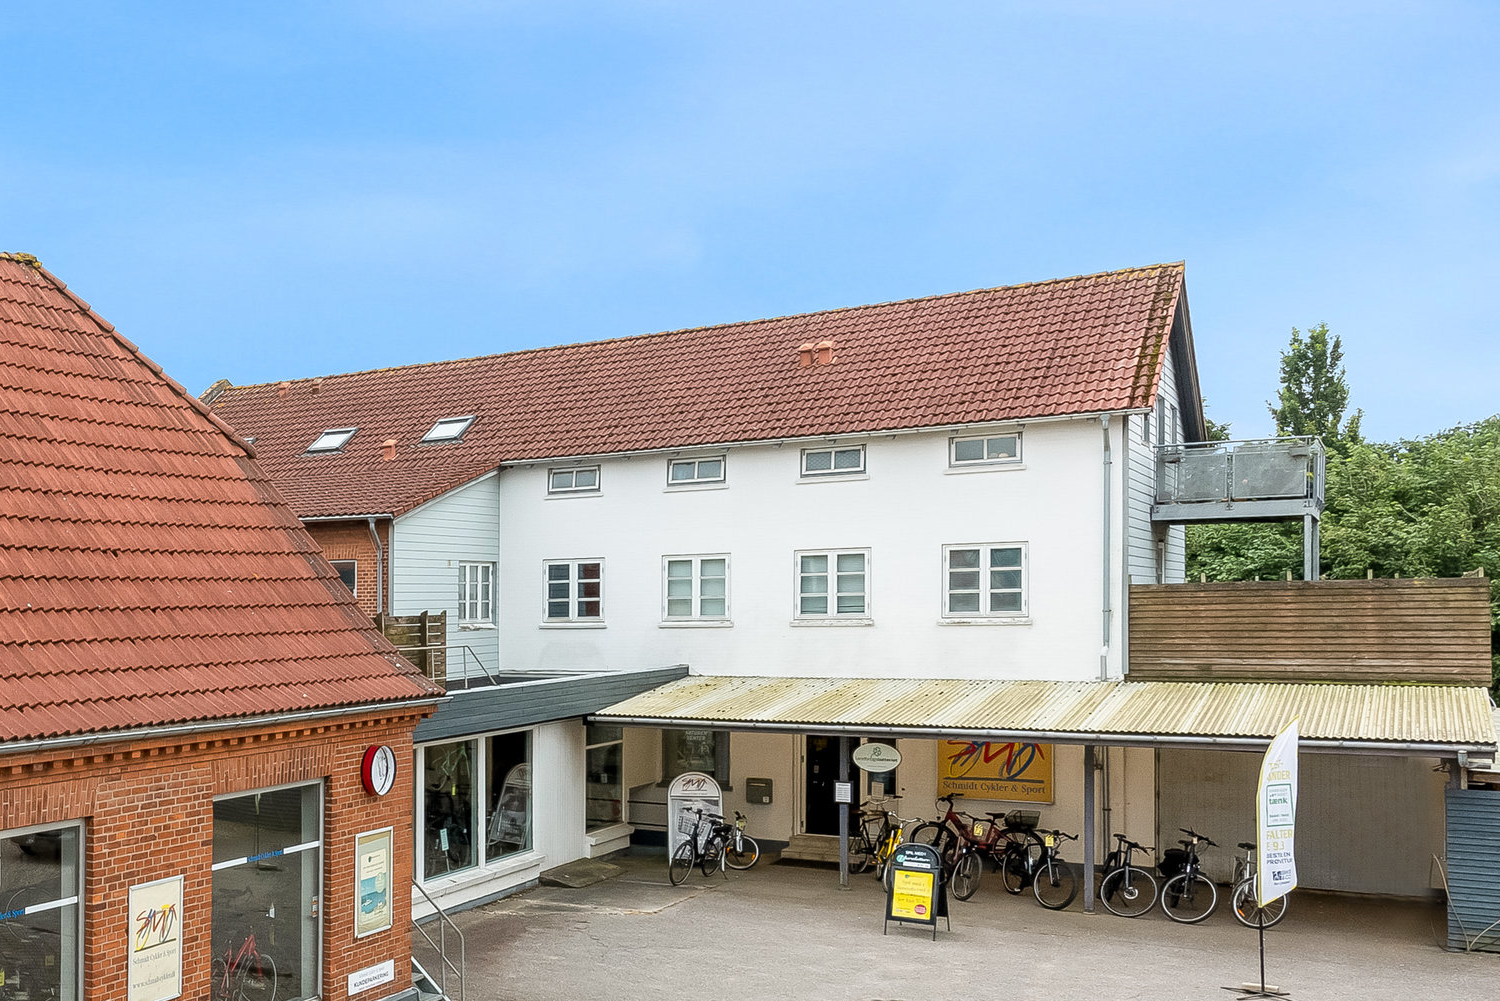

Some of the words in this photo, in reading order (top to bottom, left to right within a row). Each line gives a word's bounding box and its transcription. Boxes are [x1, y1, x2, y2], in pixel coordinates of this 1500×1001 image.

[942, 781, 978, 790] Schmidt
[980, 782, 1008, 793] Cykler
[1011, 784, 1018, 792] &
[1022, 785, 1046, 795] Sport
[132, 956, 150, 966] Schmidt
